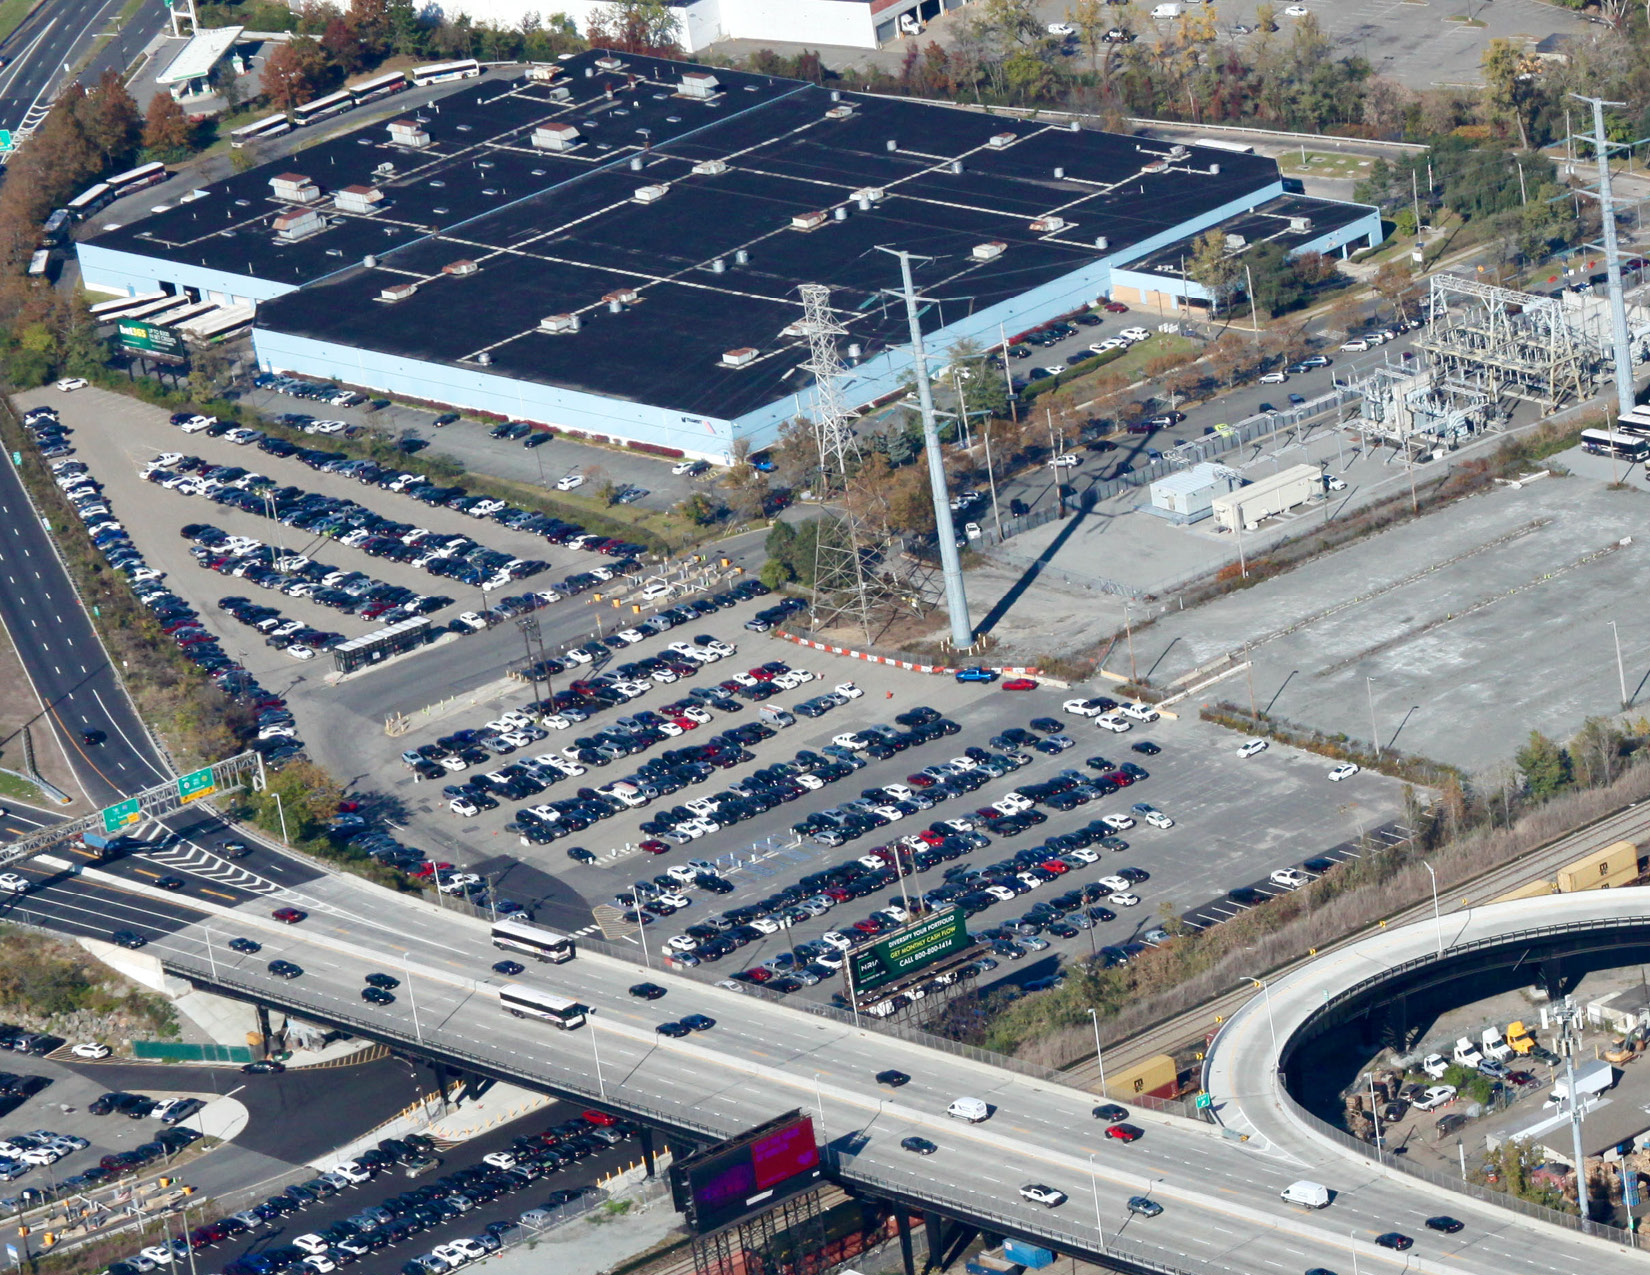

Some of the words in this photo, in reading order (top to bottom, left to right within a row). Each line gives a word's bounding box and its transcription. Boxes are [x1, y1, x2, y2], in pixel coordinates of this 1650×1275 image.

[119, 324, 147, 338] bet365
[889, 934, 913, 948] DIVERSIFY
[913, 926, 927, 937] YOUR
[927, 915, 955, 932] PORTFOLIO
[890, 949, 903, 959] GET
[902, 938, 926, 954] MONTHLY
[926, 932, 941, 943] CASH
[941, 926, 957, 937] FLOW
[860, 960, 880, 972] NRIA
[899, 956, 914, 967] CALL
[914, 939, 952, 961] 800-800-1414
